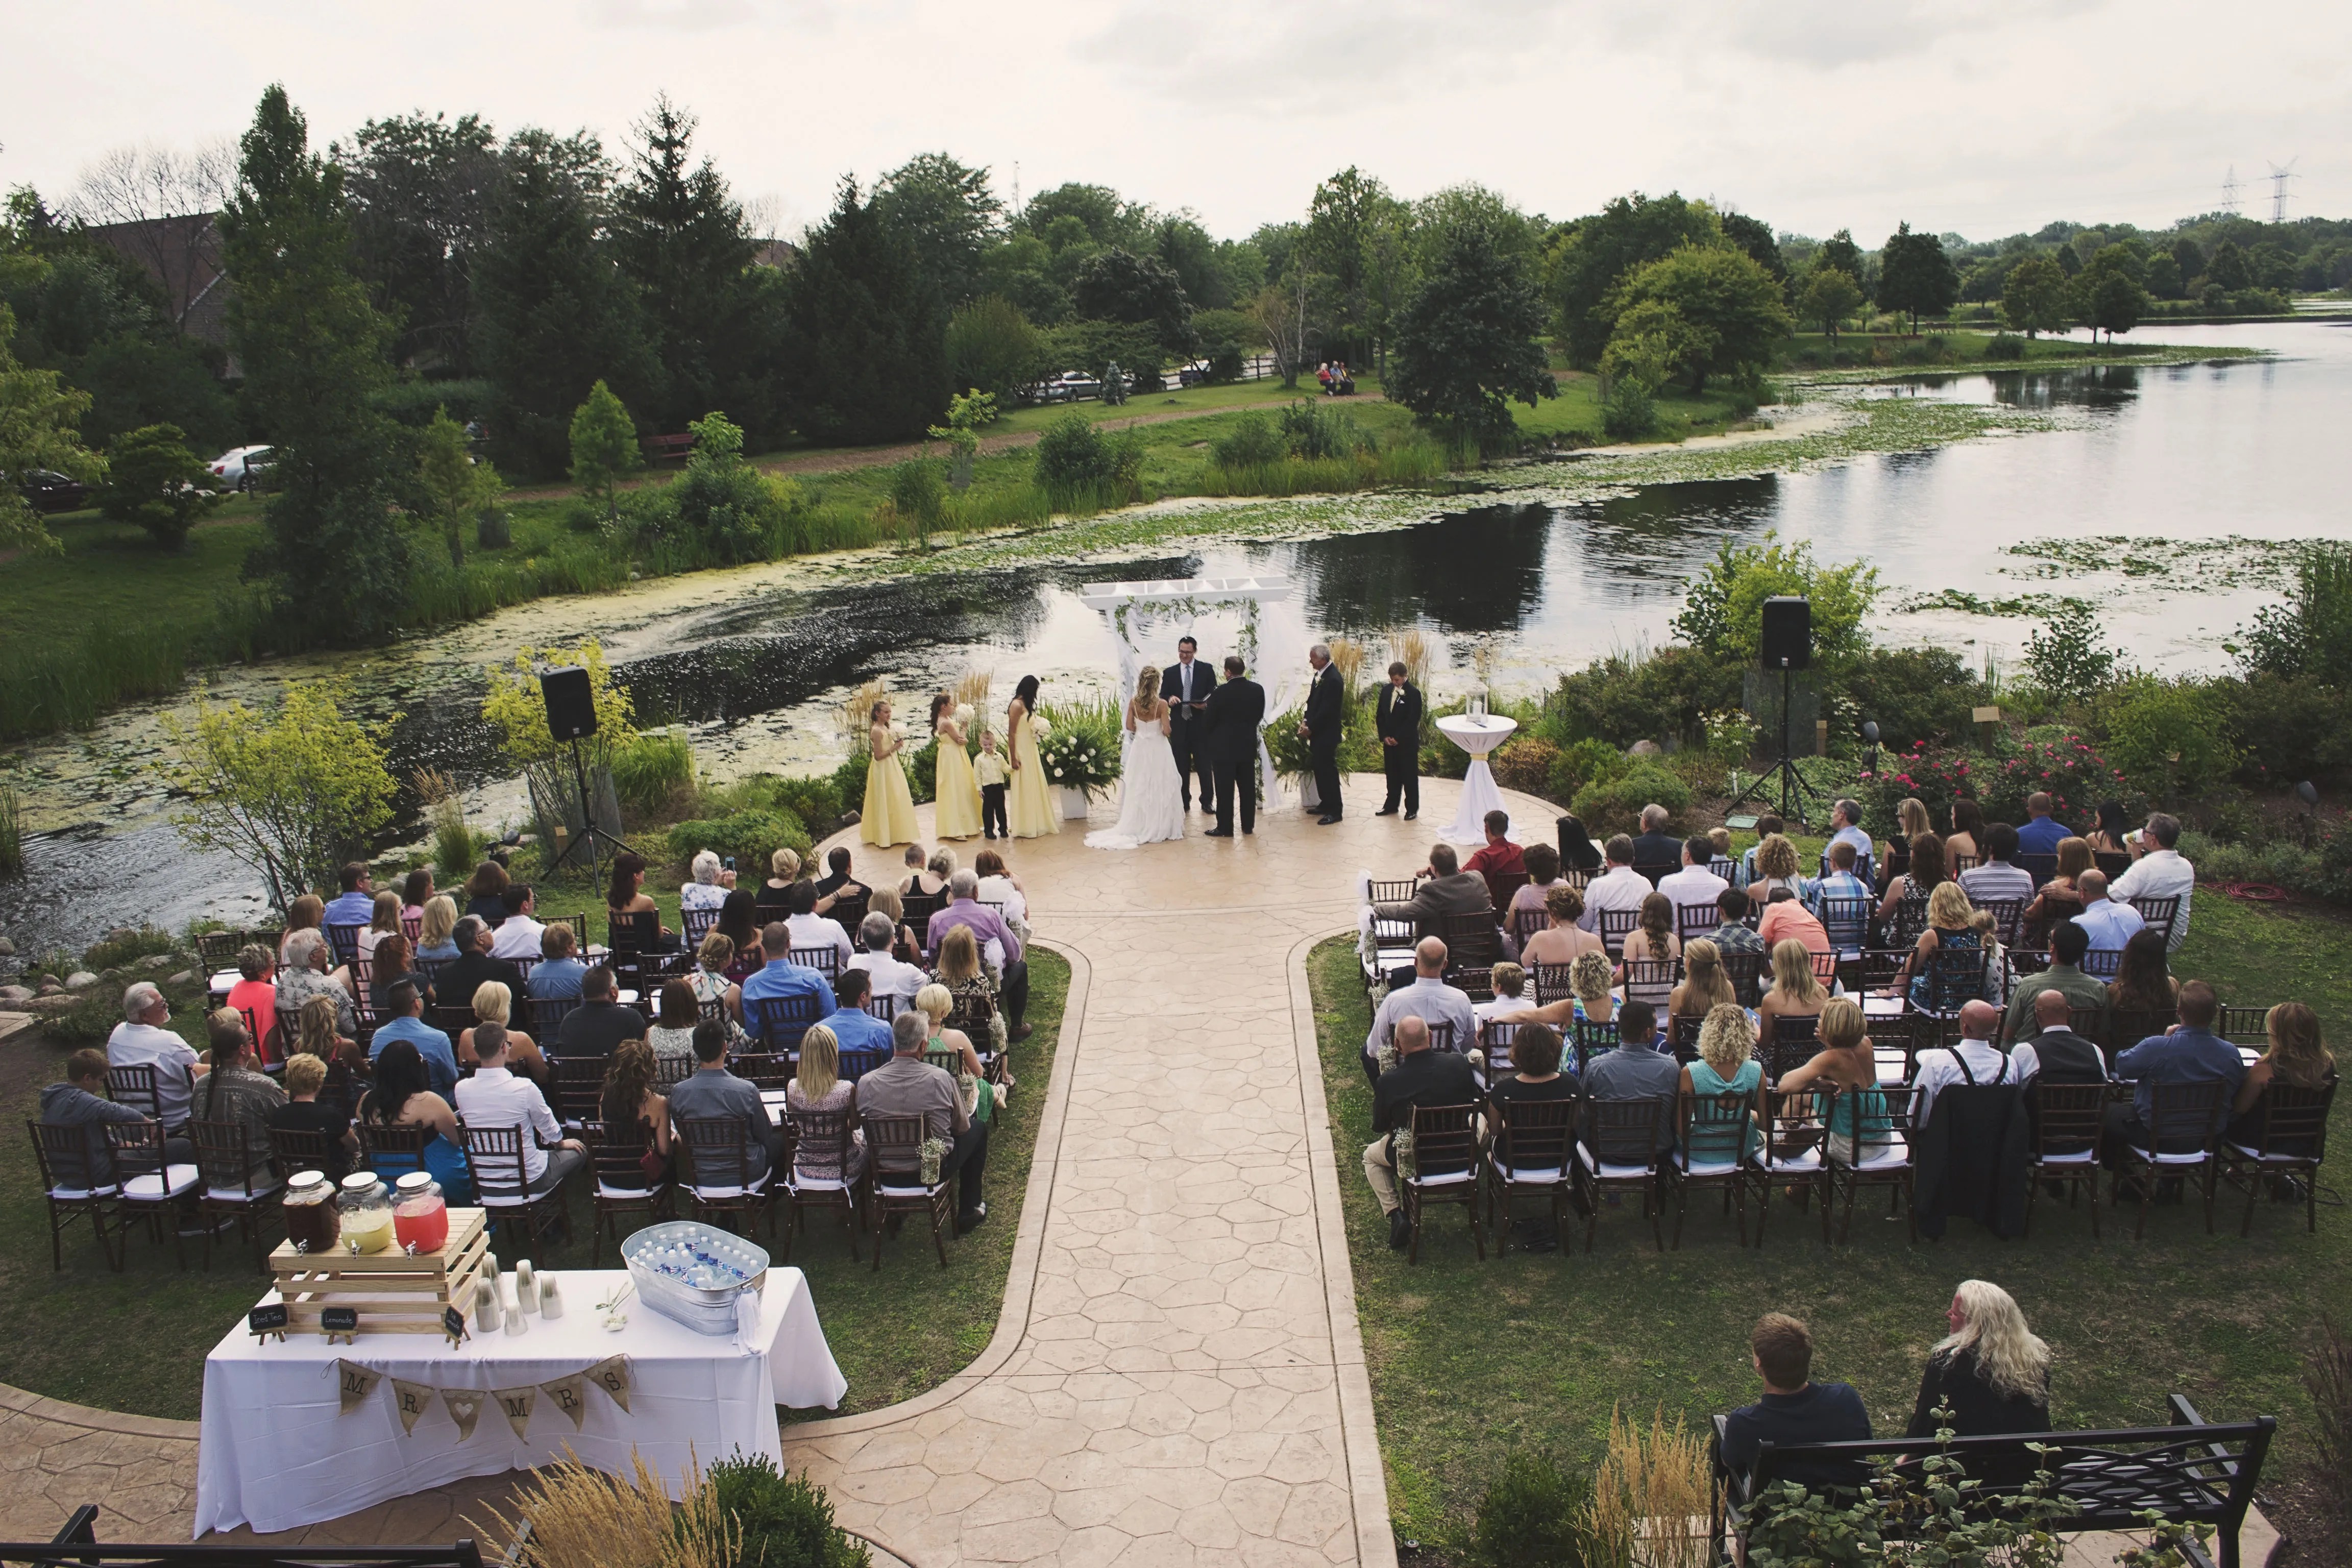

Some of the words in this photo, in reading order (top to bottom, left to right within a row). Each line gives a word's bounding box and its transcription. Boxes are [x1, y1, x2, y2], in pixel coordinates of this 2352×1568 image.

[253, 1313, 268, 1324] Iced
[268, 1312, 283, 1321] Tea
[325, 1314, 353, 1324] Lemonade
